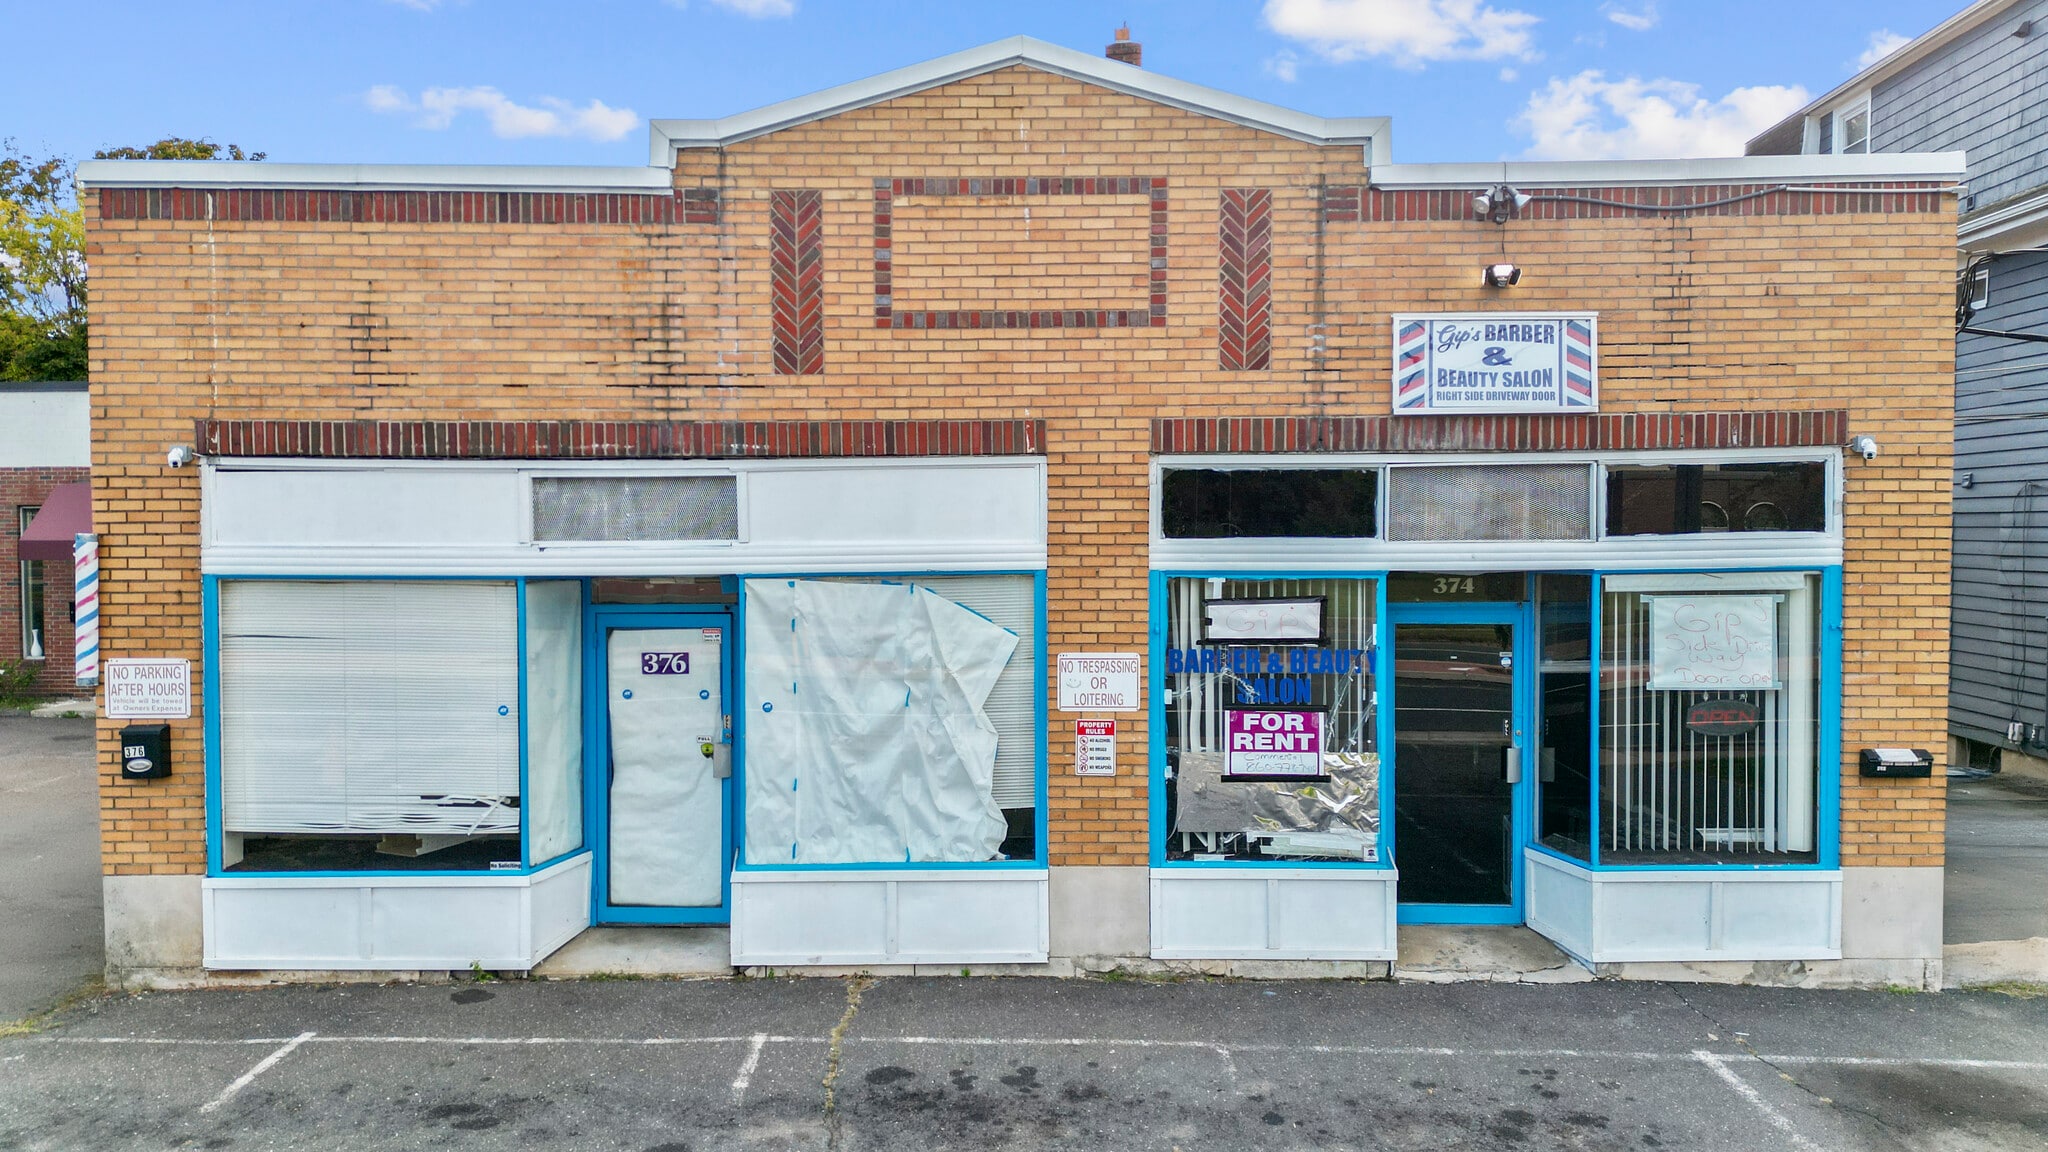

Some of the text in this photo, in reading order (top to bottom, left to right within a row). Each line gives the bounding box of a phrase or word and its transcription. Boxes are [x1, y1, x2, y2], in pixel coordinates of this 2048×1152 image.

[1437, 324, 1555, 353] Gip's BARBER
[1482, 346, 1512, 367] &
[1437, 368, 1553, 388] BEAUTY SALON
[1437, 391, 1556, 401] RIGHT SIDE DRIVEWAY DOOR
[1432, 577, 1475, 594] 374
[643, 653, 687, 674] 376
[1060, 660, 1137, 673] NO TRESPASSING
[1267, 653, 1284, 673] &
[112, 666, 182, 680] NO PARKING
[111, 682, 185, 697] AFTER HOURS
[1090, 676, 1107, 690] OR
[1238, 678, 1311, 703] SALON
[151, 704, 182, 712] Expense
[1074, 693, 1124, 706] LOITERING
[1243, 713, 1304, 731] FOR
[1691, 709, 1755, 726] OPEN
[1233, 732, 1315, 750] RENT
[125, 747, 144, 757] 376
